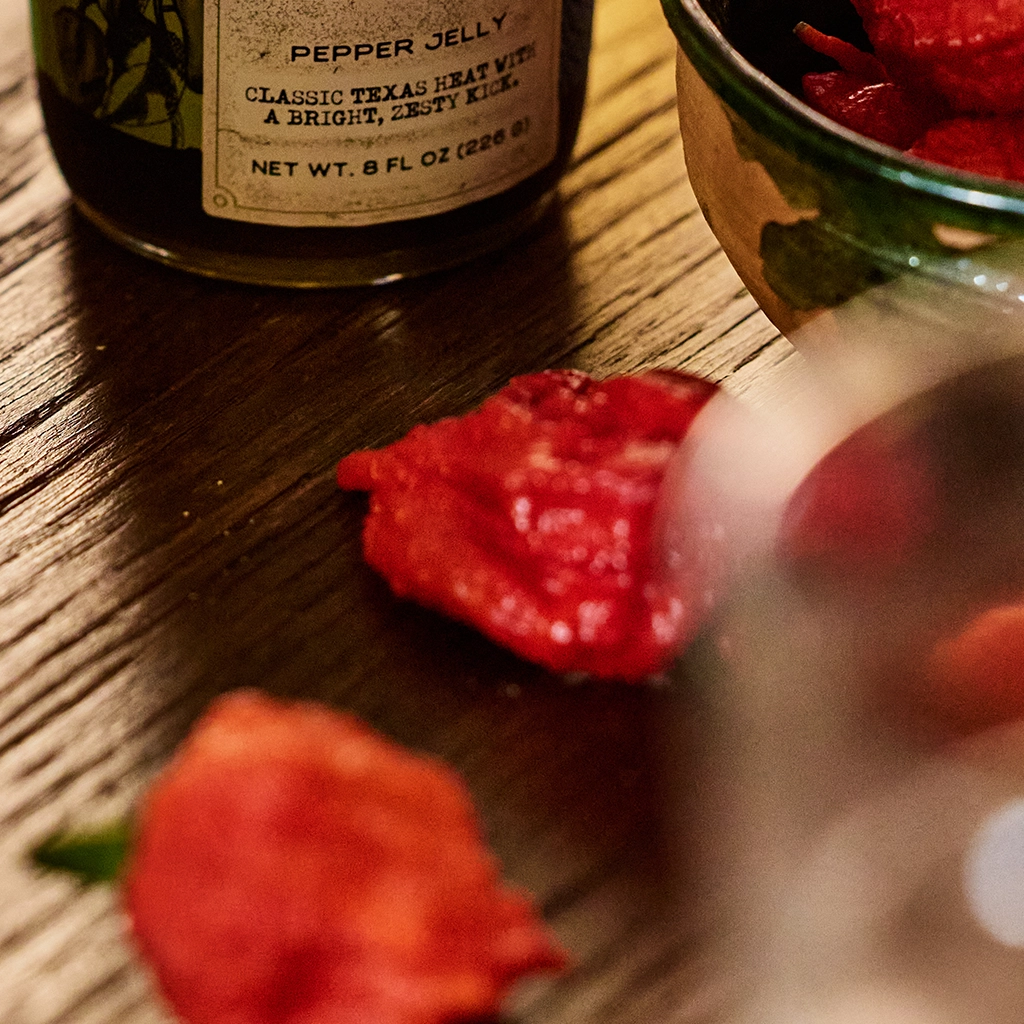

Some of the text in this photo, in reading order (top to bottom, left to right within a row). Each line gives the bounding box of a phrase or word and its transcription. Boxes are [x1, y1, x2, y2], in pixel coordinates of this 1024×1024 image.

[291, 12, 507, 62] PEPPER JELLY
[245, 87, 343, 105] CLASSIC
[351, 80, 427, 105] TEXAS
[434, 62, 489, 94] HEAT
[264, 74, 519, 126] A BRIGHT, ZESTY KICK.
[252, 160, 298, 176] NET
[308, 161, 355, 177] WT.
[362, 160, 379, 175] 8
[387, 157, 412, 173] FL
[421, 148, 450, 166] OZ
